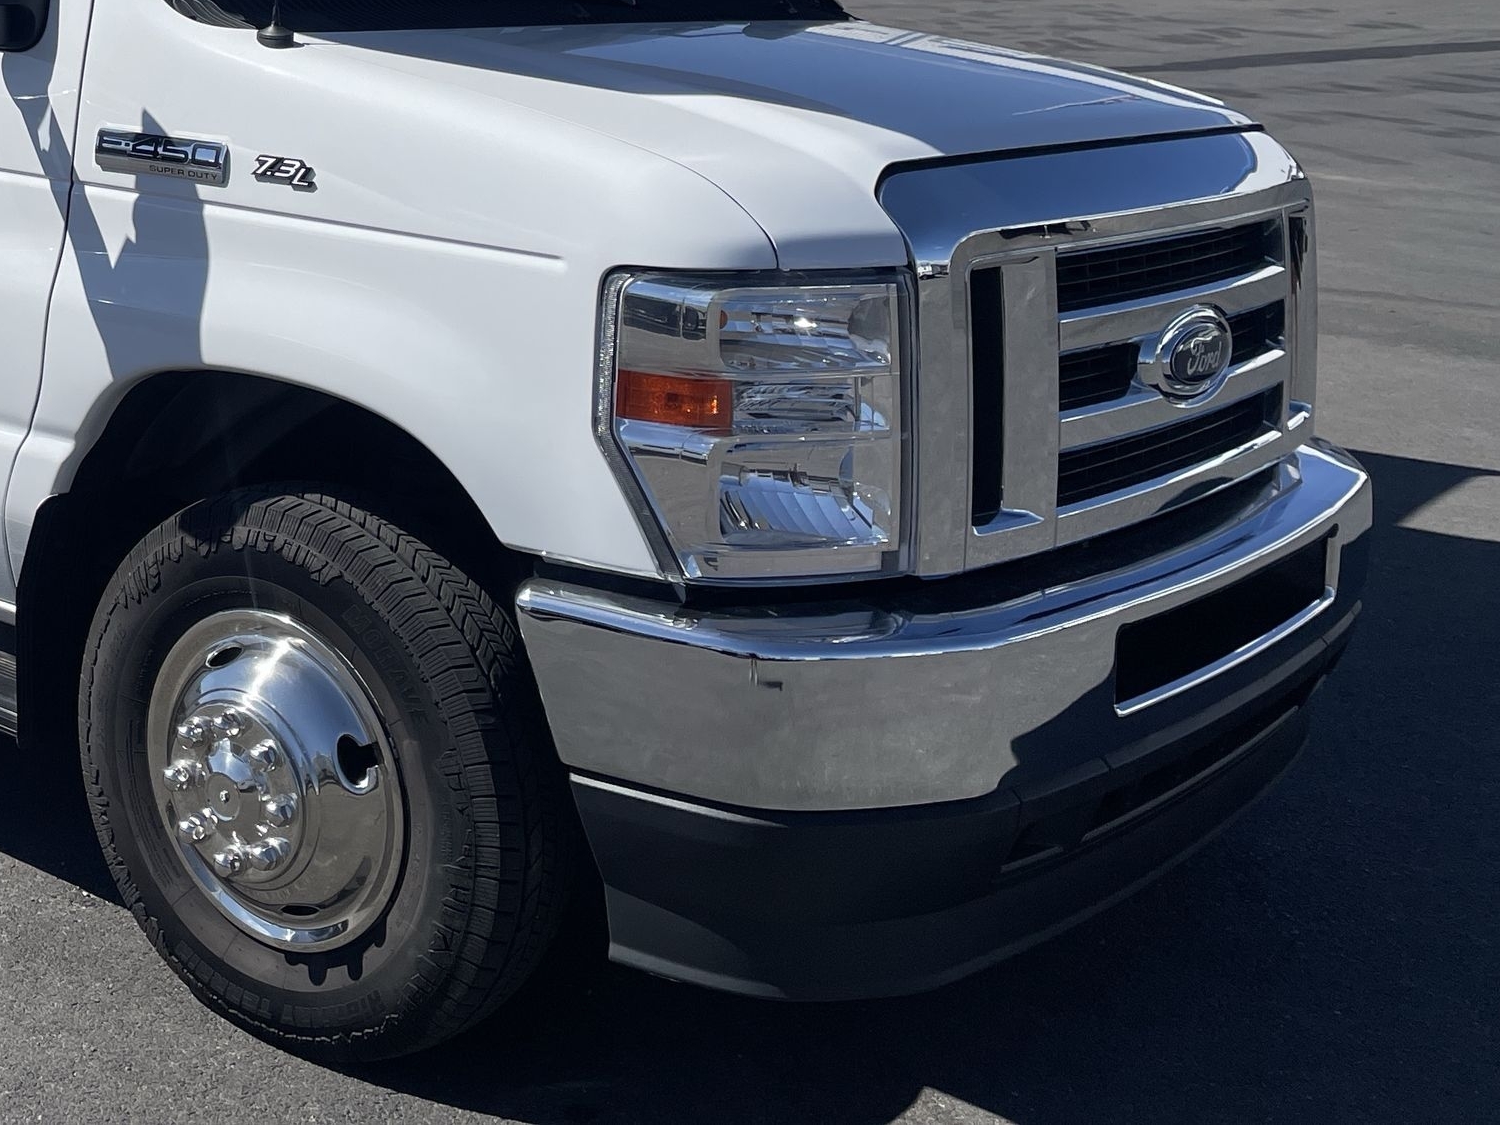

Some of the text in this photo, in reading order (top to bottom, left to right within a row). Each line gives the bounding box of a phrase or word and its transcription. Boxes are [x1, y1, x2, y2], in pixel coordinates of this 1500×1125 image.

[149, 165, 218, 181] SUPER DUTY
[1187, 336, 1222, 375] Ford
